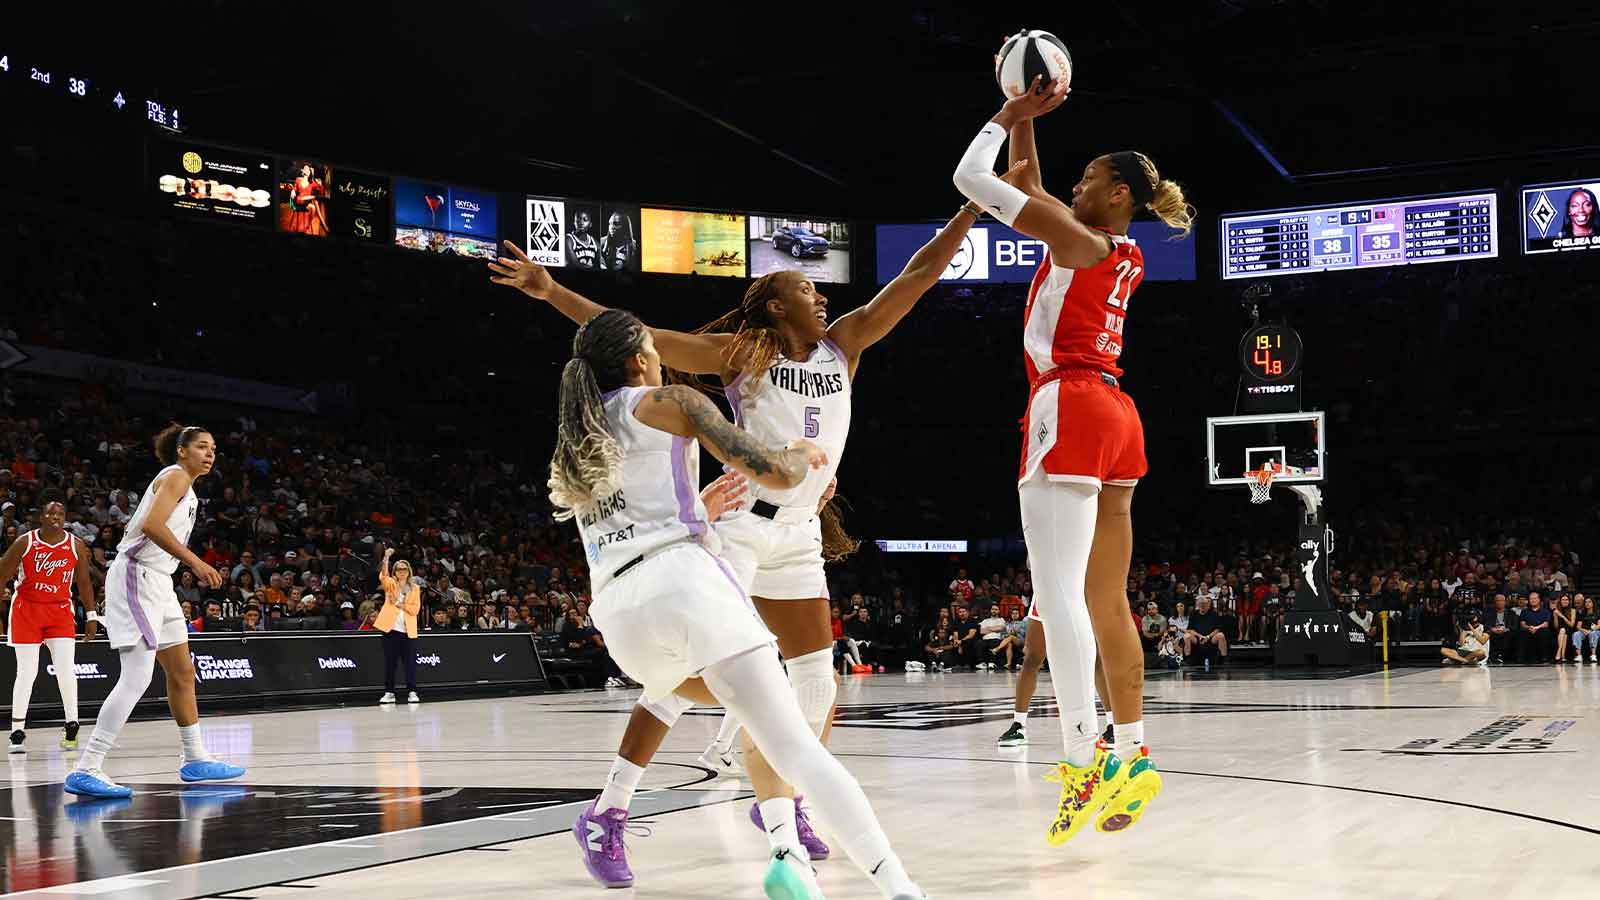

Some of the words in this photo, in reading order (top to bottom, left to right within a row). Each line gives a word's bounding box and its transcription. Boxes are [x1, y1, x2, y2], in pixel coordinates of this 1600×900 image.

[31, 68, 50, 84] 2nd
[69, 77, 86, 96] 38
[146, 100, 166, 115] TOL:
[172, 109, 178, 119] 4
[147, 111, 167, 125] FLS:
[1323, 240, 1342, 253] 38
[1372, 235, 1390, 249] 35
[1552, 237, 1590, 247] CHELSEA
[1256, 334, 1281, 350] 19.1
[1254, 350, 1282, 375] 4.8
[769, 367, 843, 398] VALKYRIES
[804, 406, 820, 438] 5
[597, 524, 635, 552] AT&T
[1300, 540, 1320, 550] ally
[34, 551, 47, 562] Las
[35, 552, 68, 577] Vegas
[62, 571, 71, 583] 12
[34, 582, 60, 594] IPSY
[198, 658, 251, 670] CHANGE
[318, 657, 357, 669] Deloitte.
[200, 668, 253, 680] MAKERS
